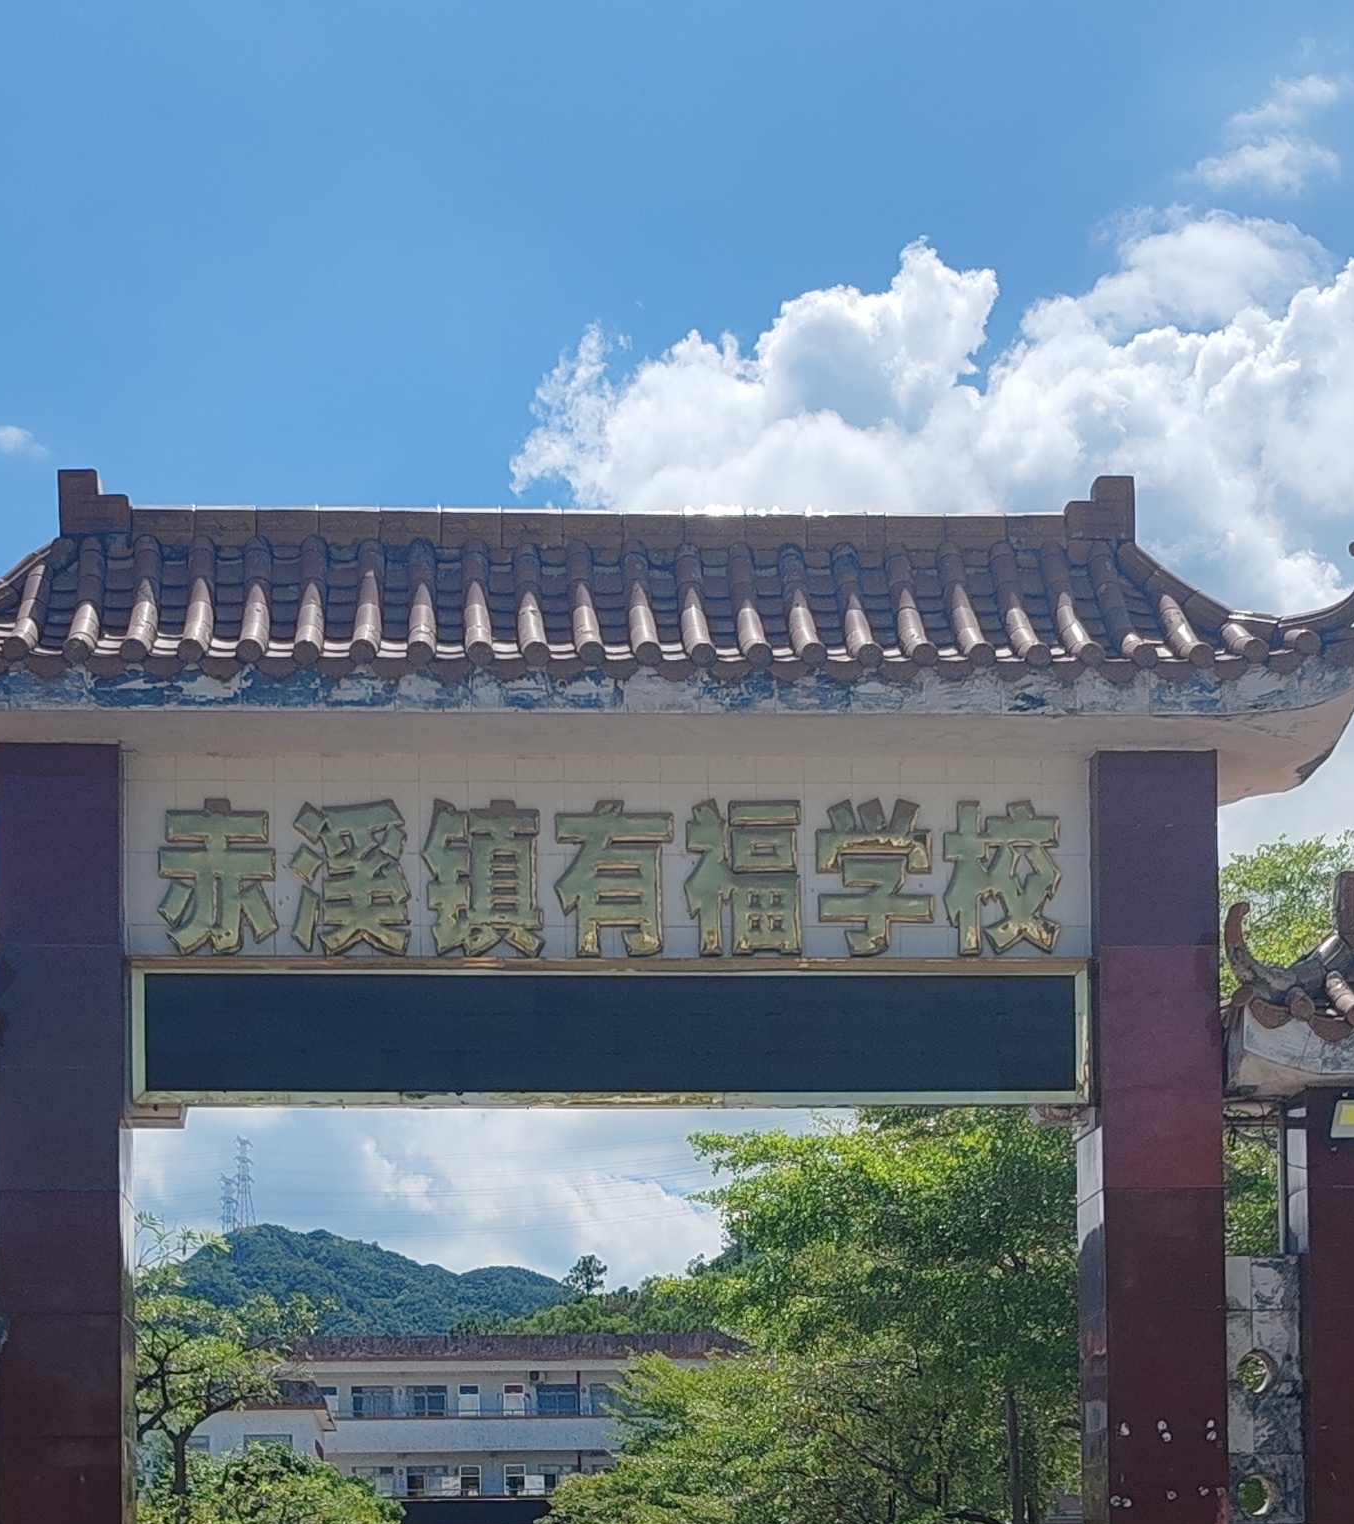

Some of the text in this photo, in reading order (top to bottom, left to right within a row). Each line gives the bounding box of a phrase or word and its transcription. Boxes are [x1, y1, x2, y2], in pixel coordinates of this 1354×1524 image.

[158, 799, 1062, 958] 赤溪镇有福学校
